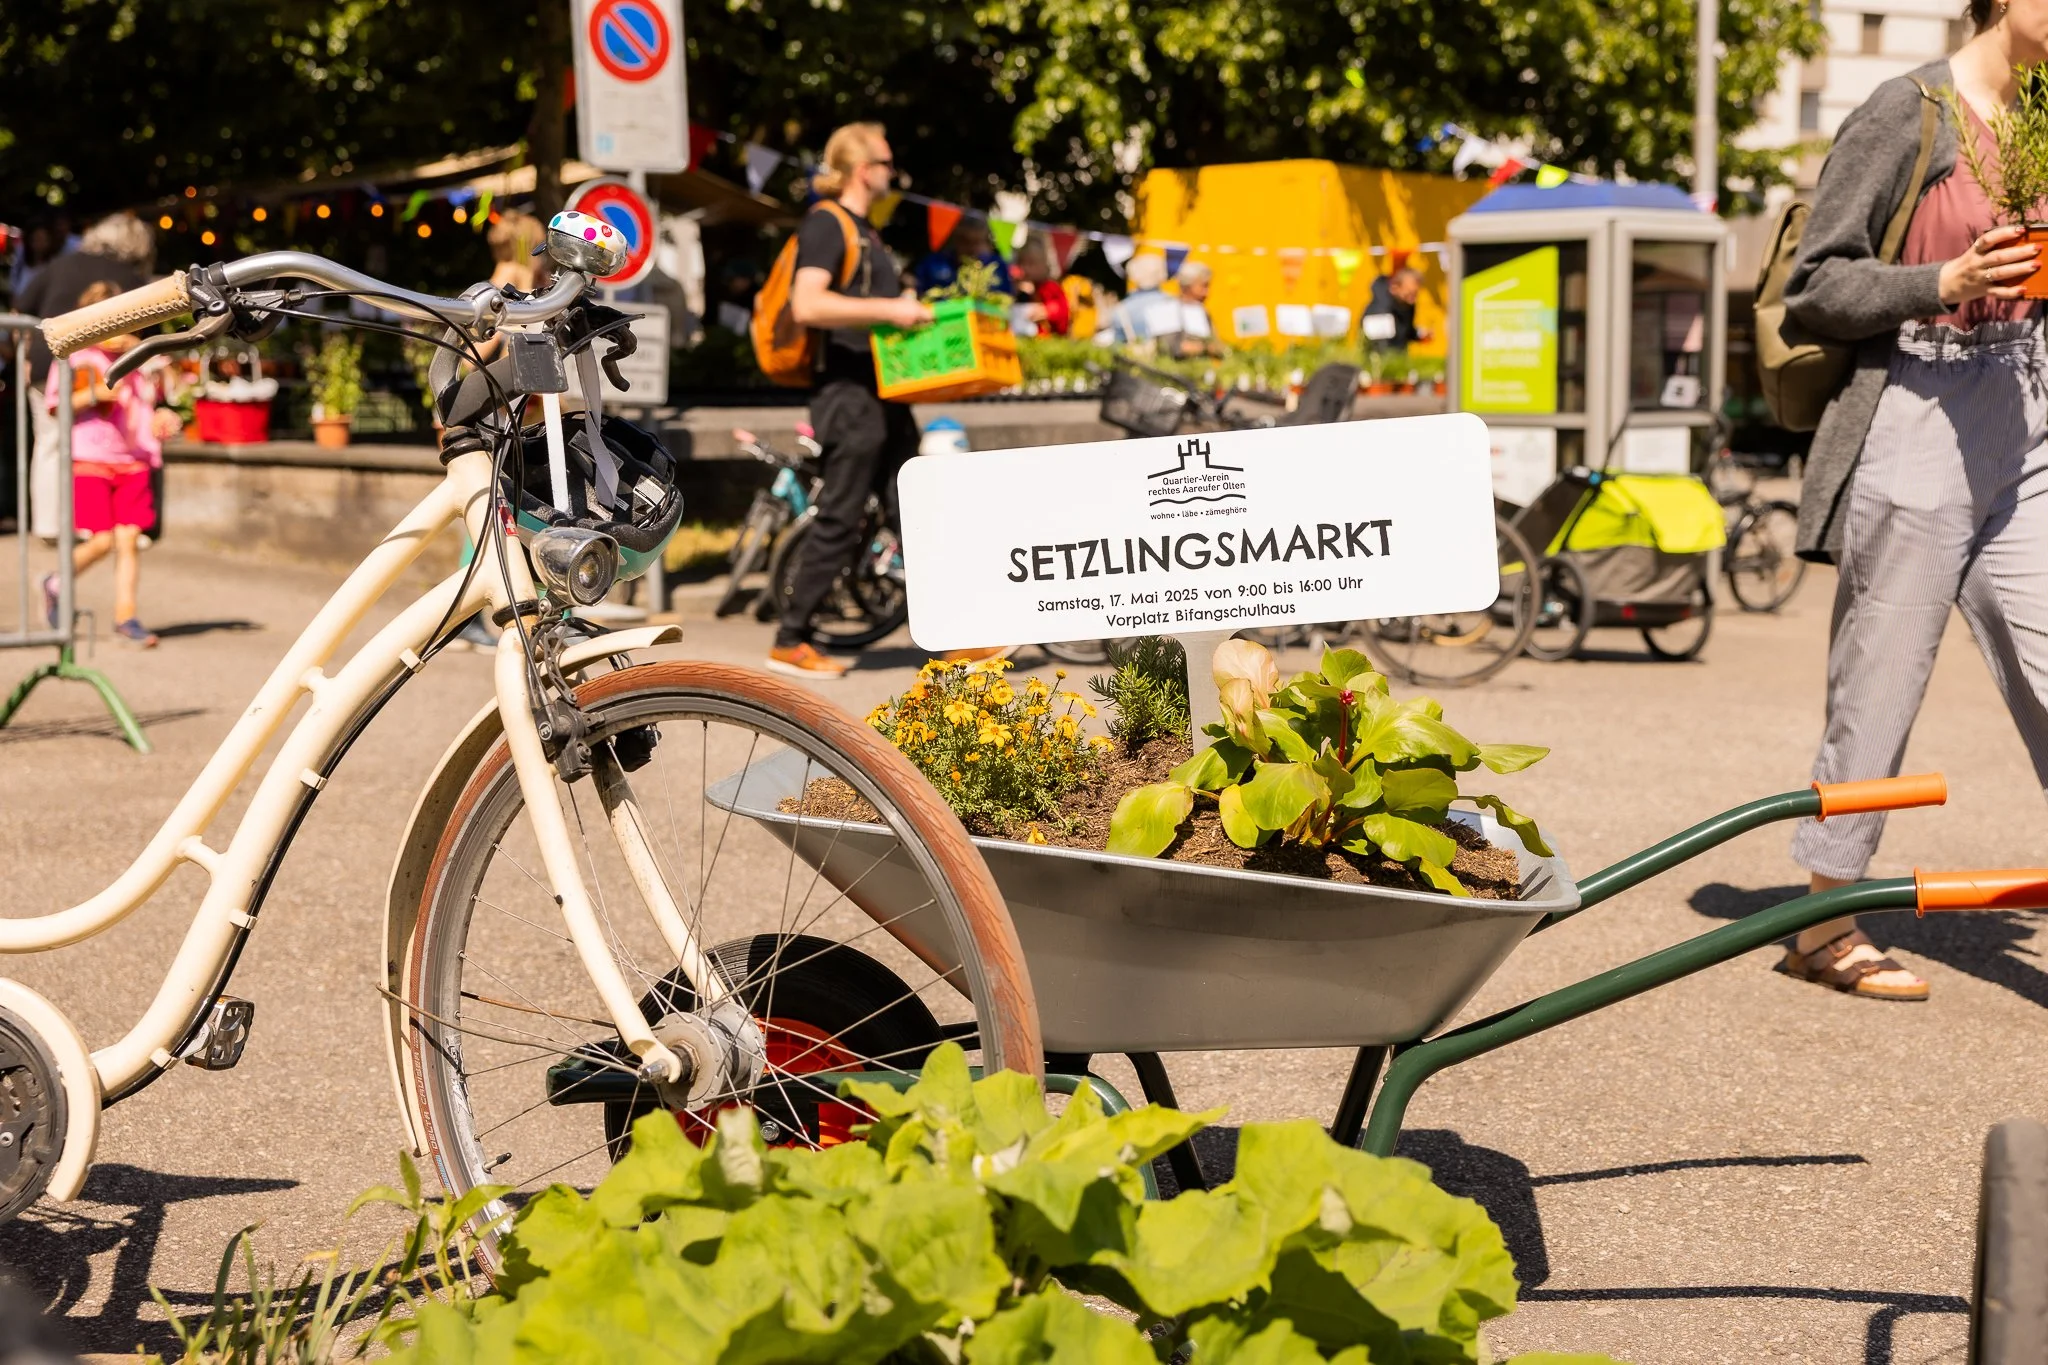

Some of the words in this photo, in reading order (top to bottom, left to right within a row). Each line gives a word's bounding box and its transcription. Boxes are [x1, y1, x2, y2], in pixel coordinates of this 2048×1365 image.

[1148, 486, 1181, 496] rechtes
[1182, 483, 1220, 494] Aareufer
[1222, 481, 1246, 491] Olten
[1162, 473, 1230, 486] Quartier-Verein
[1150, 511, 1175, 520] wohne
[1181, 510, 1199, 518] läbe
[1205, 506, 1247, 517] zämeghöre
[1007, 519, 1393, 583] SETZLINGSMARKT
[1037, 597, 1105, 612] Samstag,
[1109, 593, 1125, 607] 17.
[1130, 591, 1158, 605] Mai
[1164, 588, 1199, 603] 2025
[1204, 588, 1232, 600] von
[1237, 583, 1267, 597] 9:00
[1273, 581, 1294, 595] bis
[1299, 578, 1332, 593] 16:00
[1337, 576, 1364, 591] Uhr
[1105, 611, 1170, 629] Vorplatz
[1175, 603, 1296, 622] Bifangschulhaus
